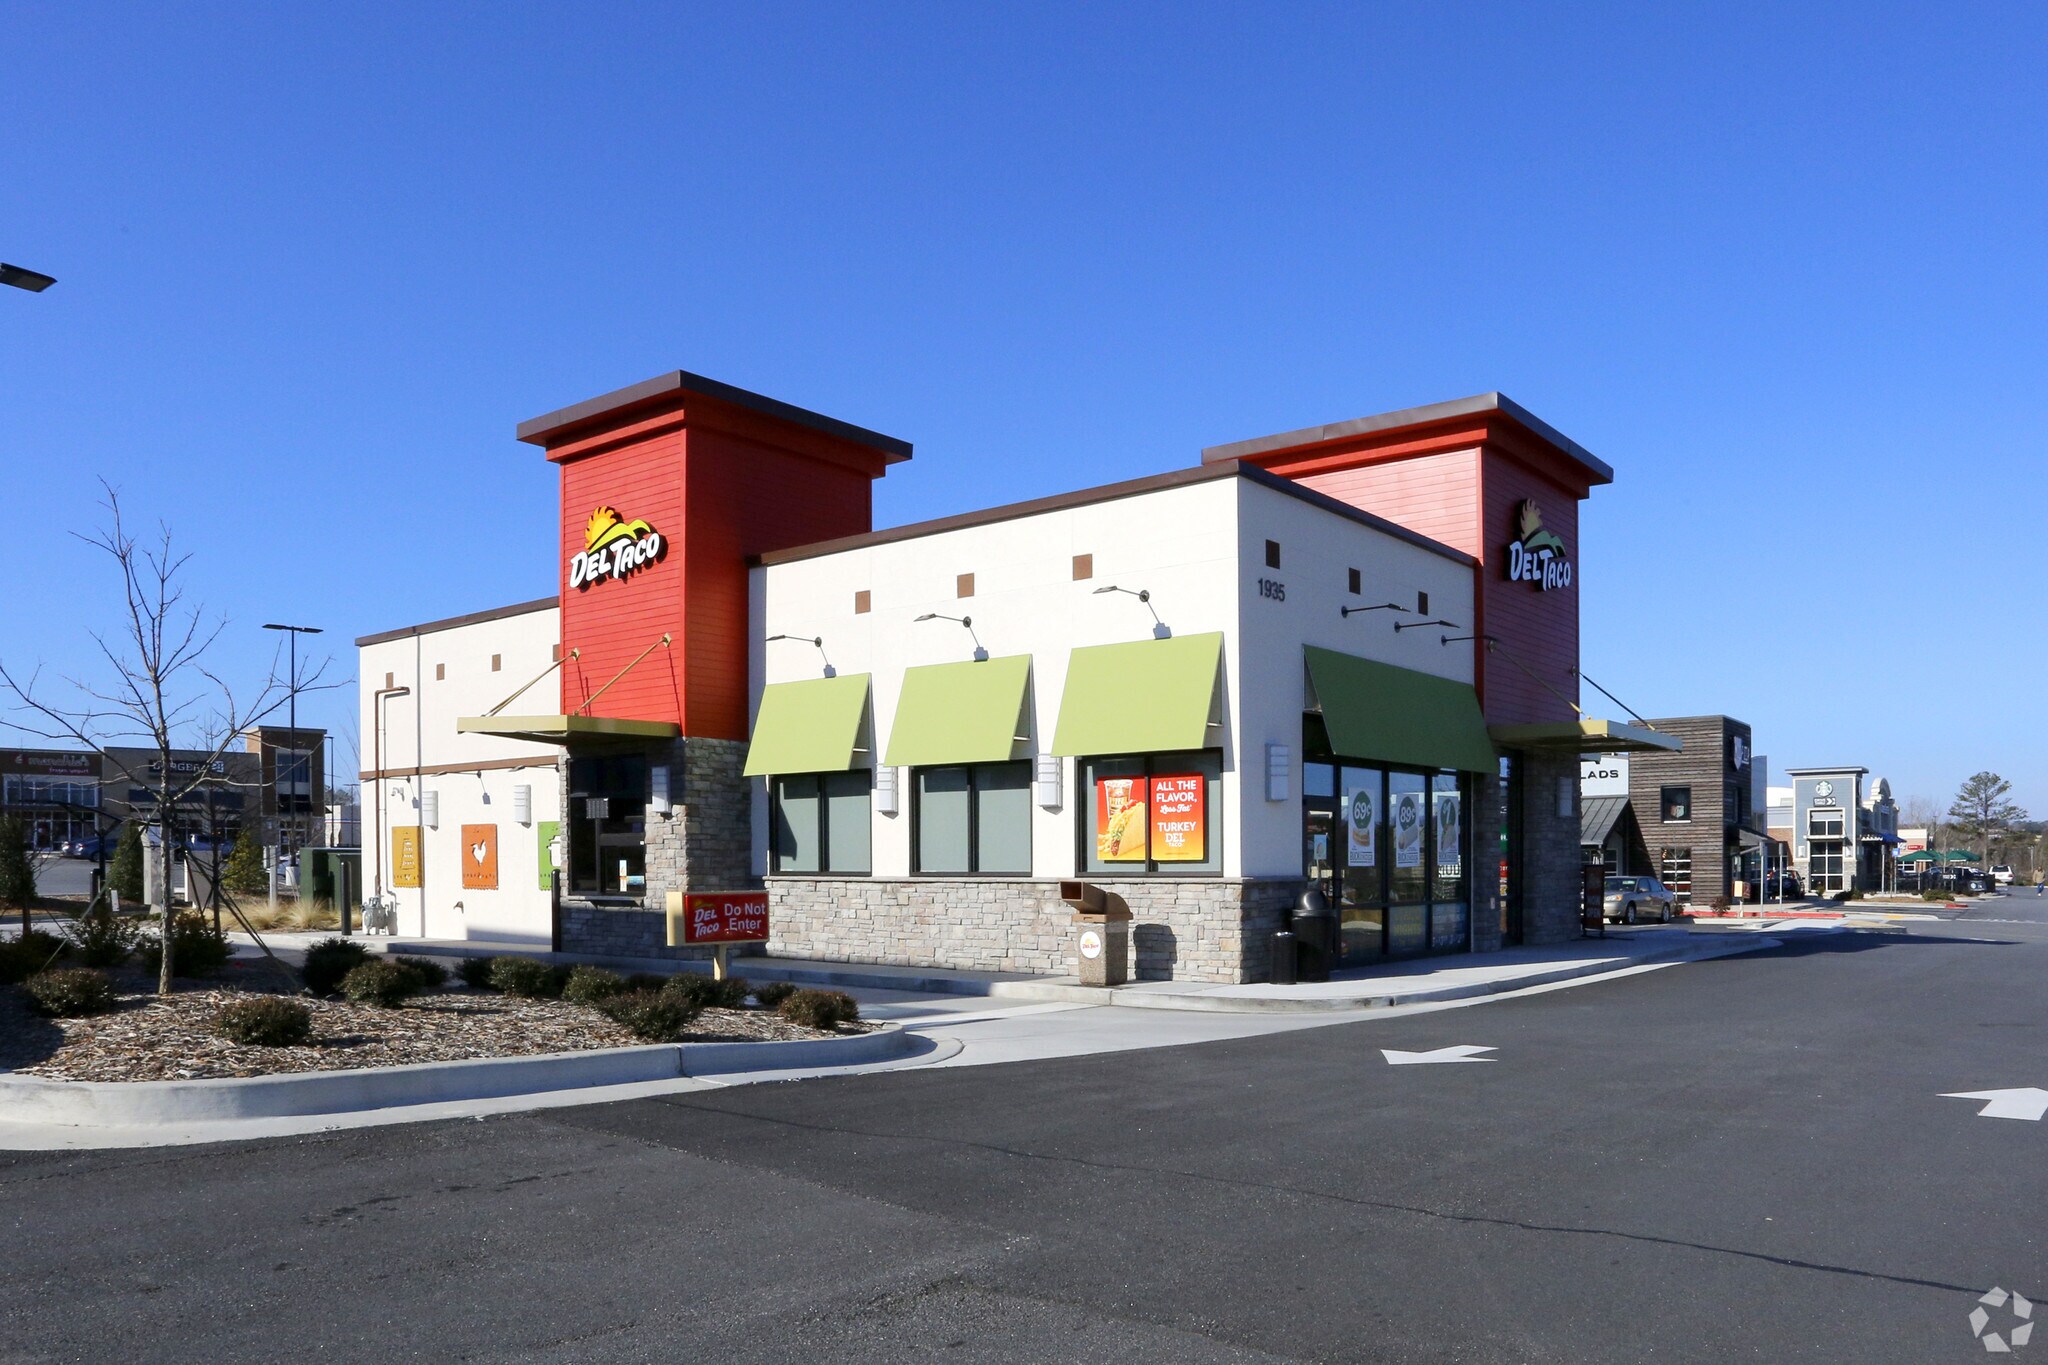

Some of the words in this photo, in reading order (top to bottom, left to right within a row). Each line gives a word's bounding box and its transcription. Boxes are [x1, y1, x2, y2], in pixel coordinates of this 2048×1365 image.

[570, 548, 611, 588] DEL
[609, 533, 660, 579] TACO
[1509, 541, 1541, 581] DEL
[1539, 549, 1571, 591] TACO
[1258, 578, 1285, 602] 1935
[153, 761, 200, 771] BRGER
[1156, 781, 1174, 791] ALL
[1176, 780, 1196, 790] THE
[1156, 792, 1197, 803] FLAVOR,
[1160, 804, 1176, 814] Less
[1353, 802, 1371, 820] 69¢
[1400, 806, 1416, 823] 89¢
[1157, 821, 1197, 832] TURKEY
[1165, 833, 1185, 843] DEL
[694, 908, 717, 922] DEL
[724, 903, 741, 916] Do
[744, 903, 765, 915] Not
[693, 922, 719, 938] TACO
[729, 917, 762, 931] Enter
